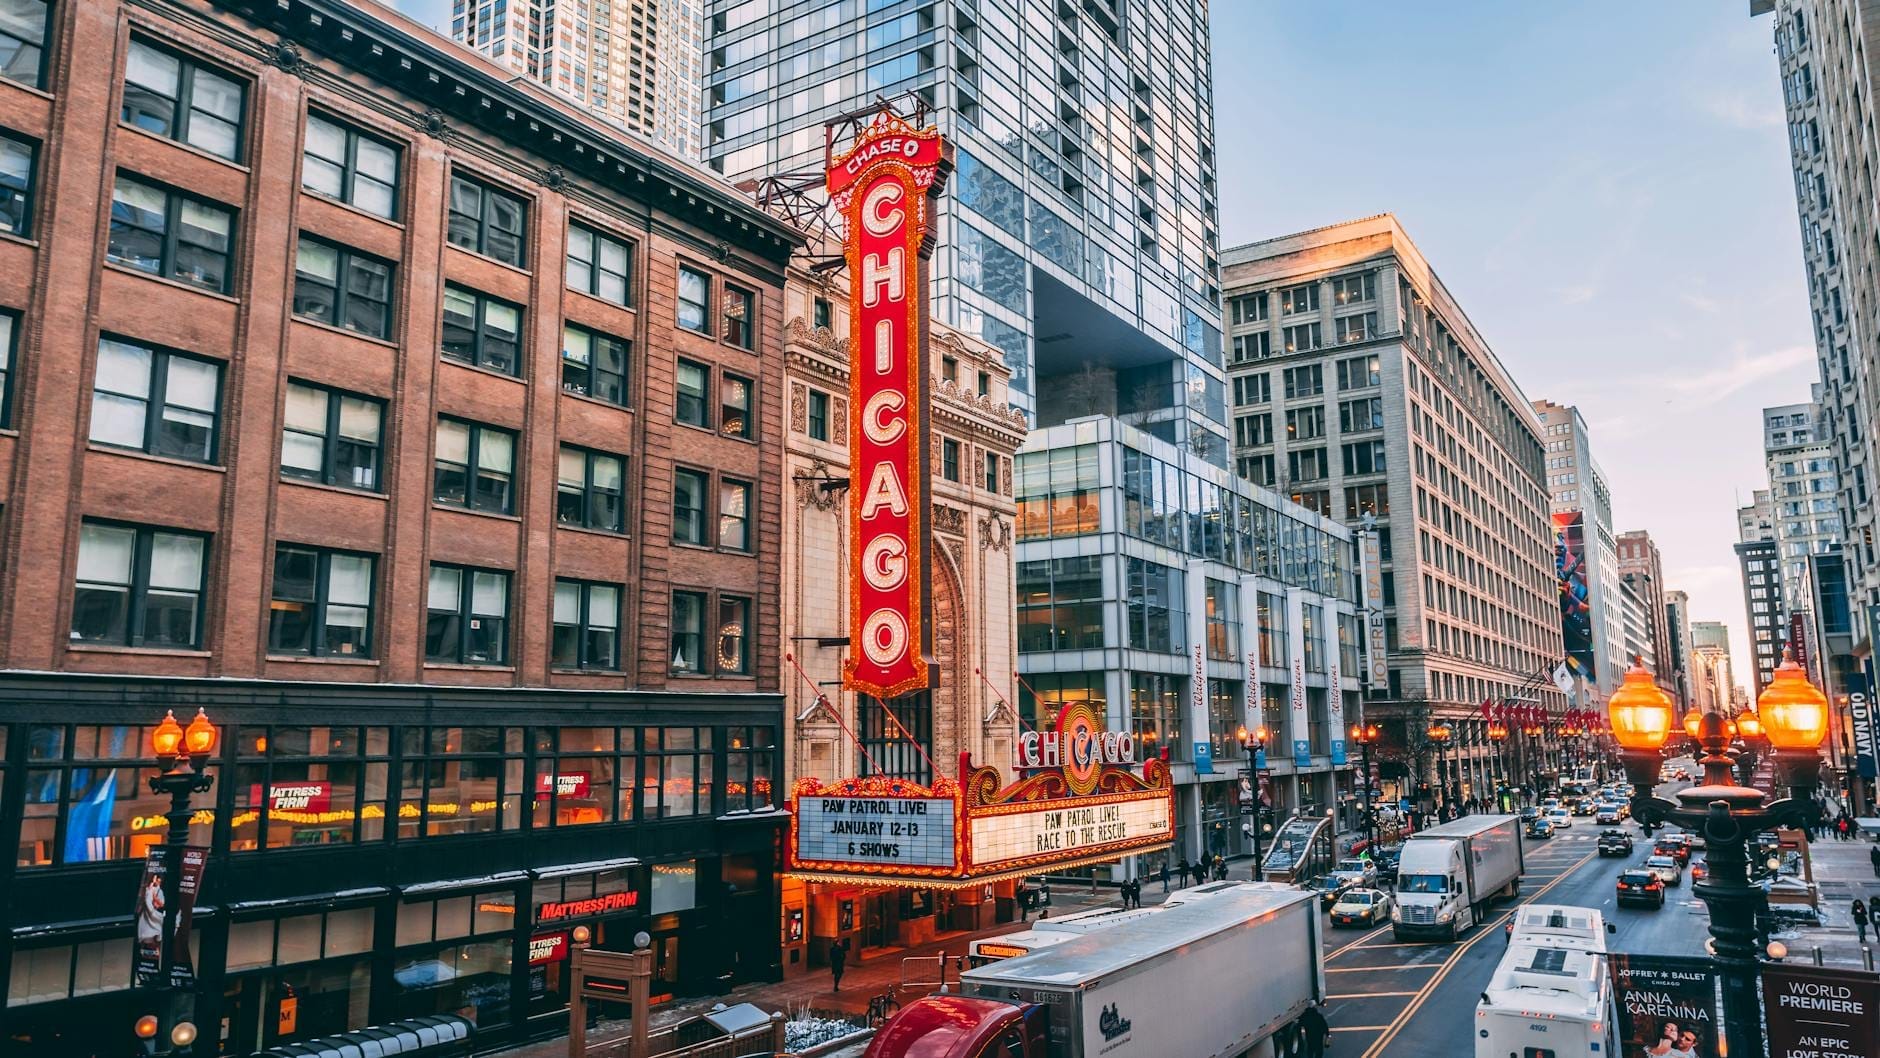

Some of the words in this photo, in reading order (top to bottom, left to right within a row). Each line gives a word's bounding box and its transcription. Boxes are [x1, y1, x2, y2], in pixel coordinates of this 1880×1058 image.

[846, 138, 902, 175] CHASE
[860, 182, 909, 667] CHICAGO
[1365, 533, 1381, 599] BALLET
[1370, 607, 1387, 688] JOFFREY
[1193, 643, 1206, 707] Walgreens
[1247, 652, 1258, 710] Walgreens
[1294, 658, 1304, 712] Walgreens
[1332, 664, 1341, 713] Walgreens
[1850, 692, 1867, 719] OLD
[1021, 730, 1135, 766] CHICAGO
[1855, 724, 1872, 757] NAVY
[544, 775, 584, 785] MTTRESS
[556, 784, 577, 794] IRM
[274, 797, 310, 809] FIRM
[822, 799, 845, 813] PAW
[850, 800, 893, 815] PATROL
[898, 801, 927, 815] LIVE!
[831, 820, 884, 836] JANUARY
[890, 822, 919, 837] 12-13
[1045, 811, 1062, 831] PAW
[1067, 809, 1096, 828] PATROL
[1100, 805, 1120, 822] LIVE!
[1037, 832, 1061, 852] RACE
[1066, 830, 1076, 846] TO
[1080, 827, 1095, 845] THE
[1099, 822, 1127, 842] RESCUE
[848, 842, 855, 856] 6
[860, 843, 900, 858] SHOWS
[529, 947, 553, 960] FIRM
[1619, 969, 1658, 978] JOFFREY
[1671, 972, 1706, 980] BALLET
[1624, 990, 1673, 1005] ANNA
[1788, 981, 1851, 999] WORLD
[1626, 1002, 1710, 1021] KARENINA
[1780, 994, 1864, 1015] PREMIERE
[1529, 1024, 1547, 1032] 4192
[1798, 1035, 1817, 1046] AN
[1820, 1037, 1850, 1049] EPIC
